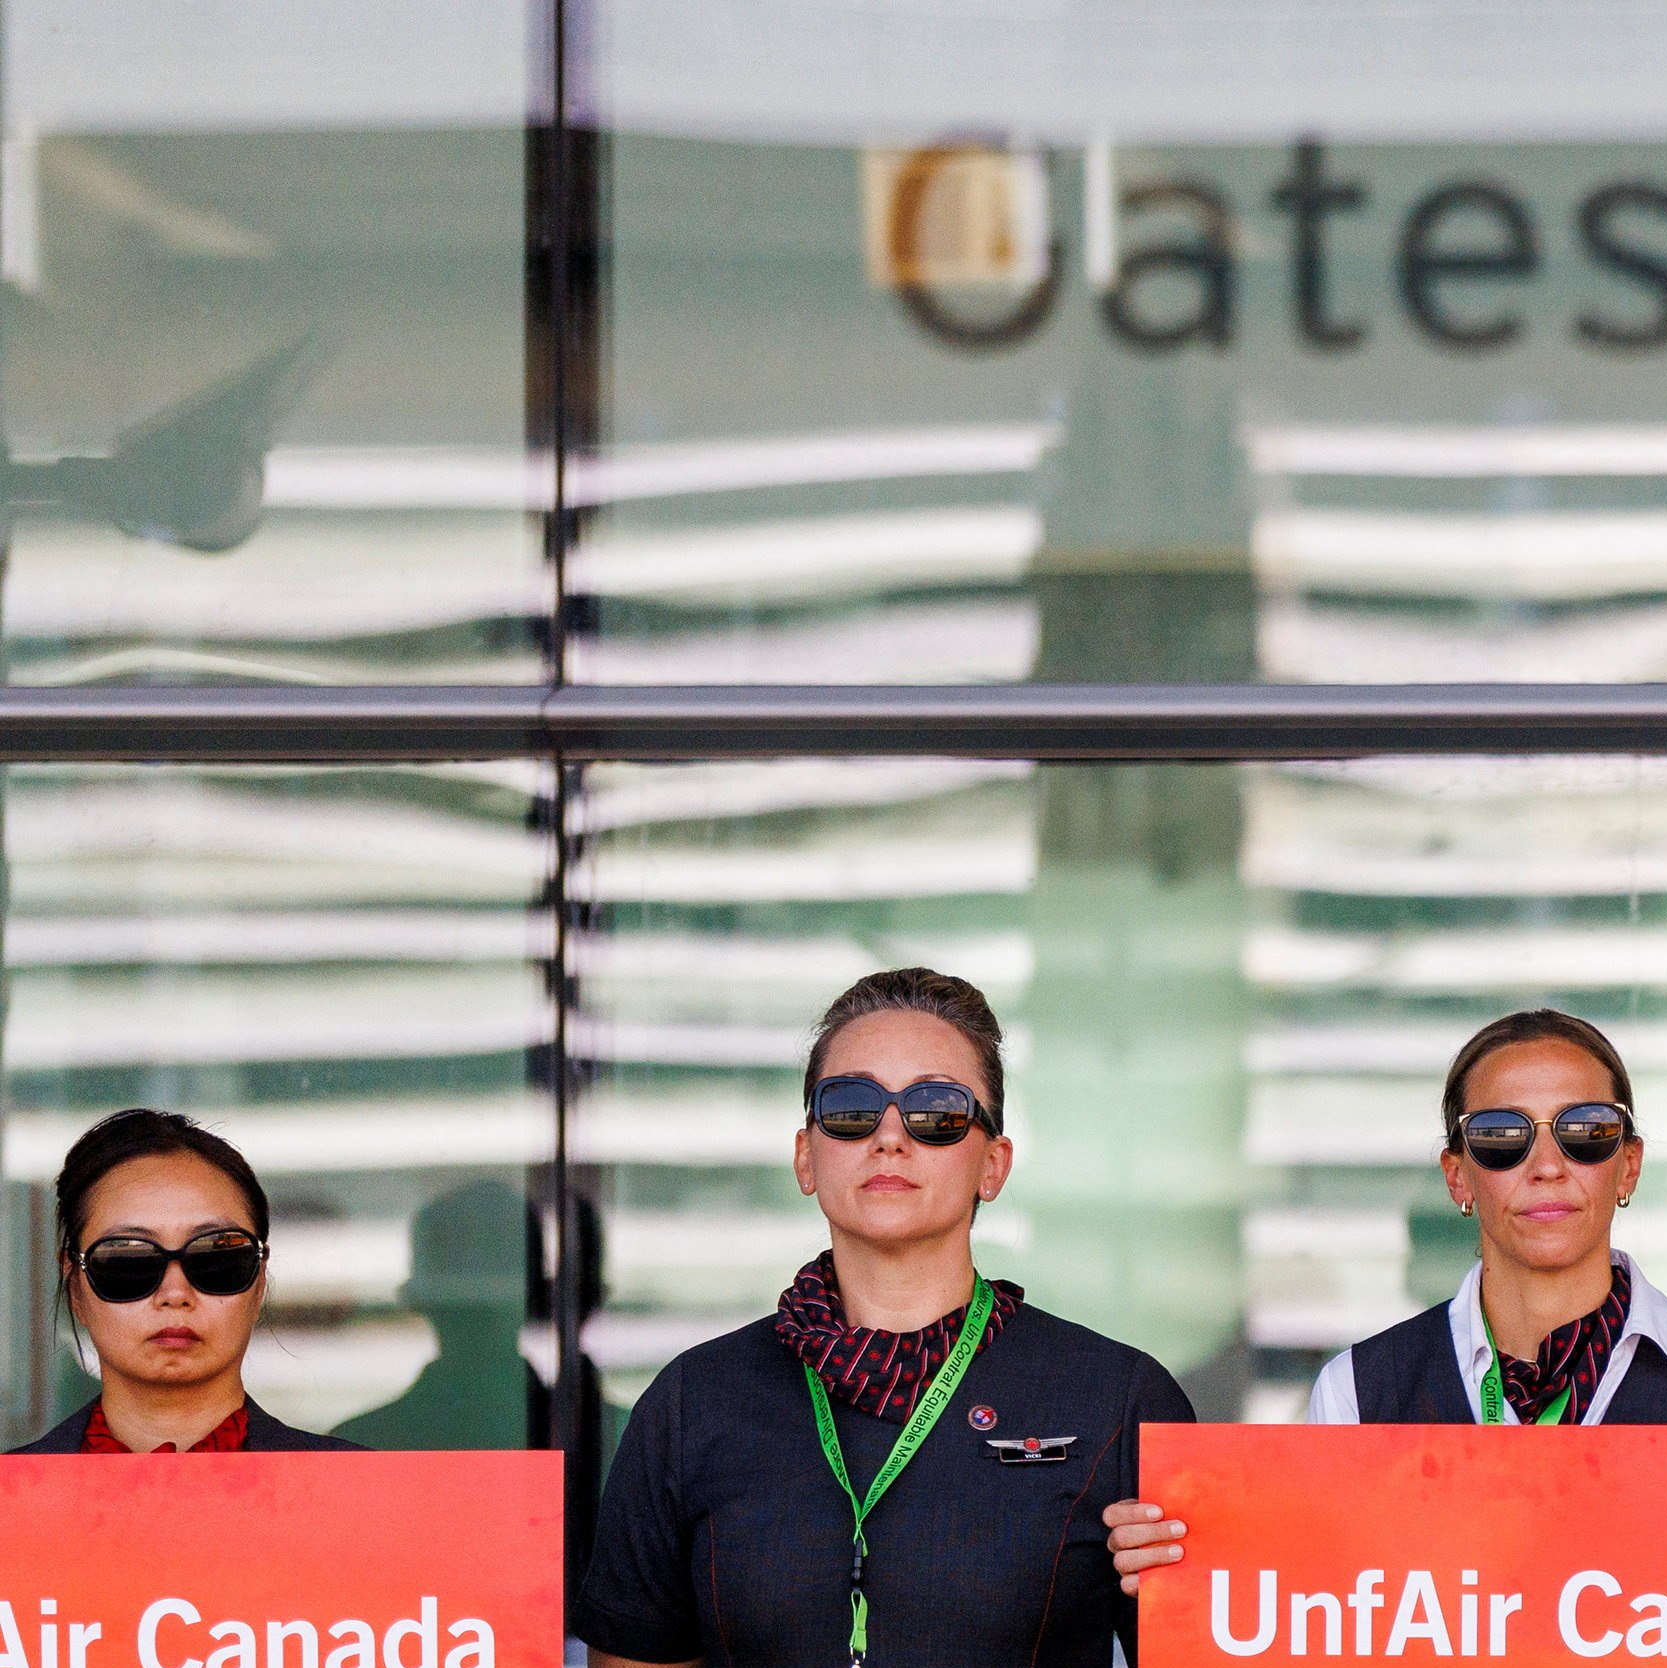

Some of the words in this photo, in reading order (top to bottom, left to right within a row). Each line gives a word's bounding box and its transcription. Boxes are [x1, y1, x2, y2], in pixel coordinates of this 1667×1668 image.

[967, 1323, 980, 1341] Un
[939, 1342, 971, 1390] Contrat
[905, 1387, 949, 1443] Équitable
[1484, 1376, 1499, 1423] Contrat
[1211, 1569, 1523, 1657] UnfAir
